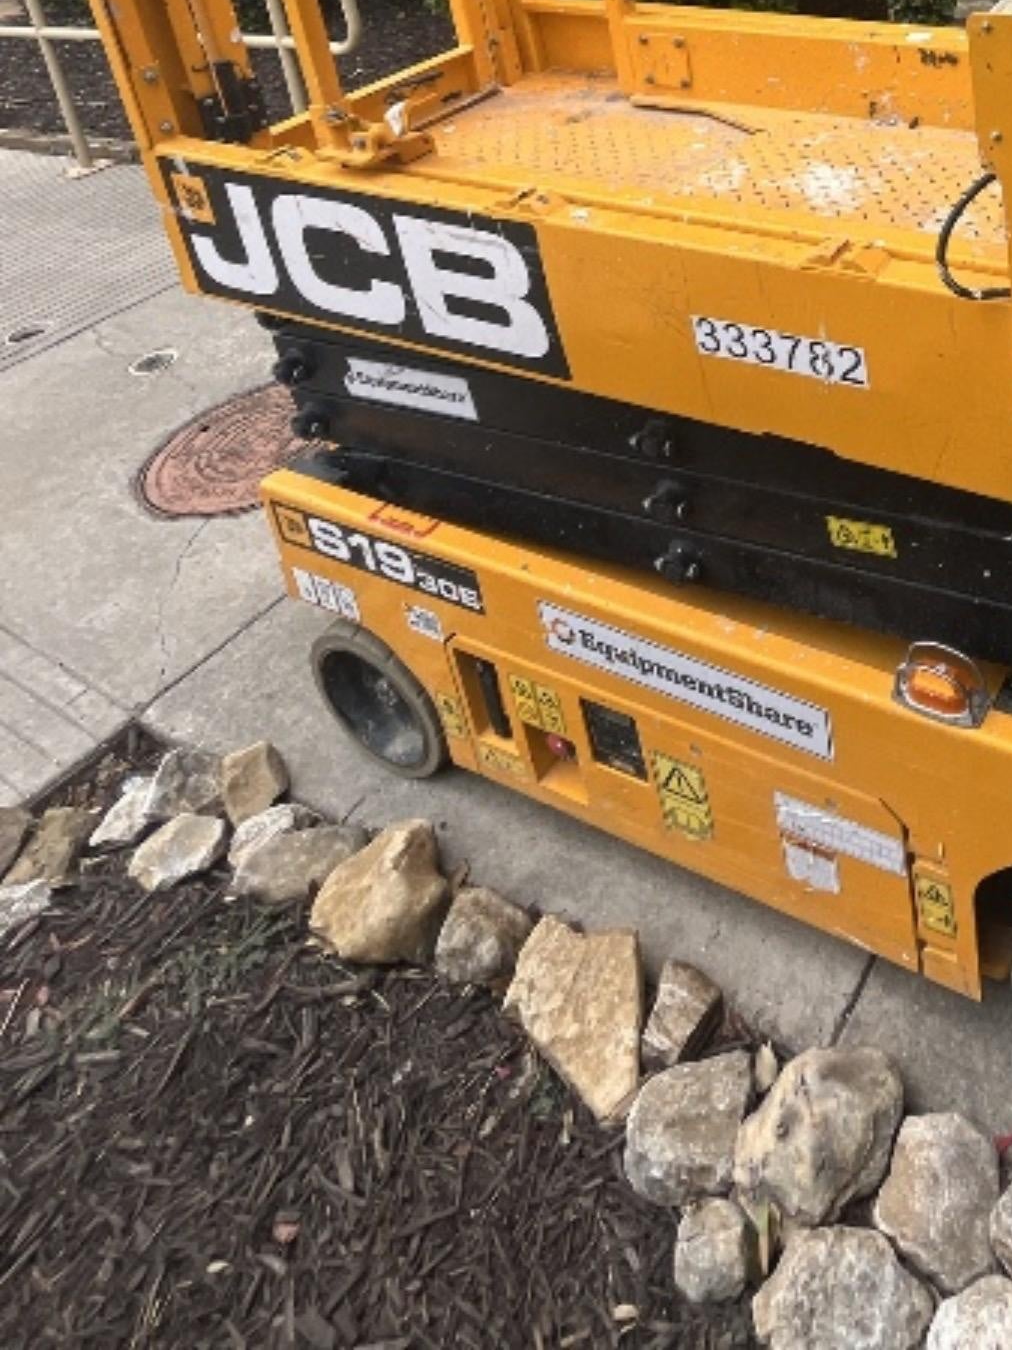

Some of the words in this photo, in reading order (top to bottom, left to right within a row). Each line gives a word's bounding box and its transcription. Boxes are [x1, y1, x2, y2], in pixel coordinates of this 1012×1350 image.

[190, 182, 549, 358] JCB
[696, 317, 865, 385] 333782
[578, 629, 815, 738] EquipmentShare
